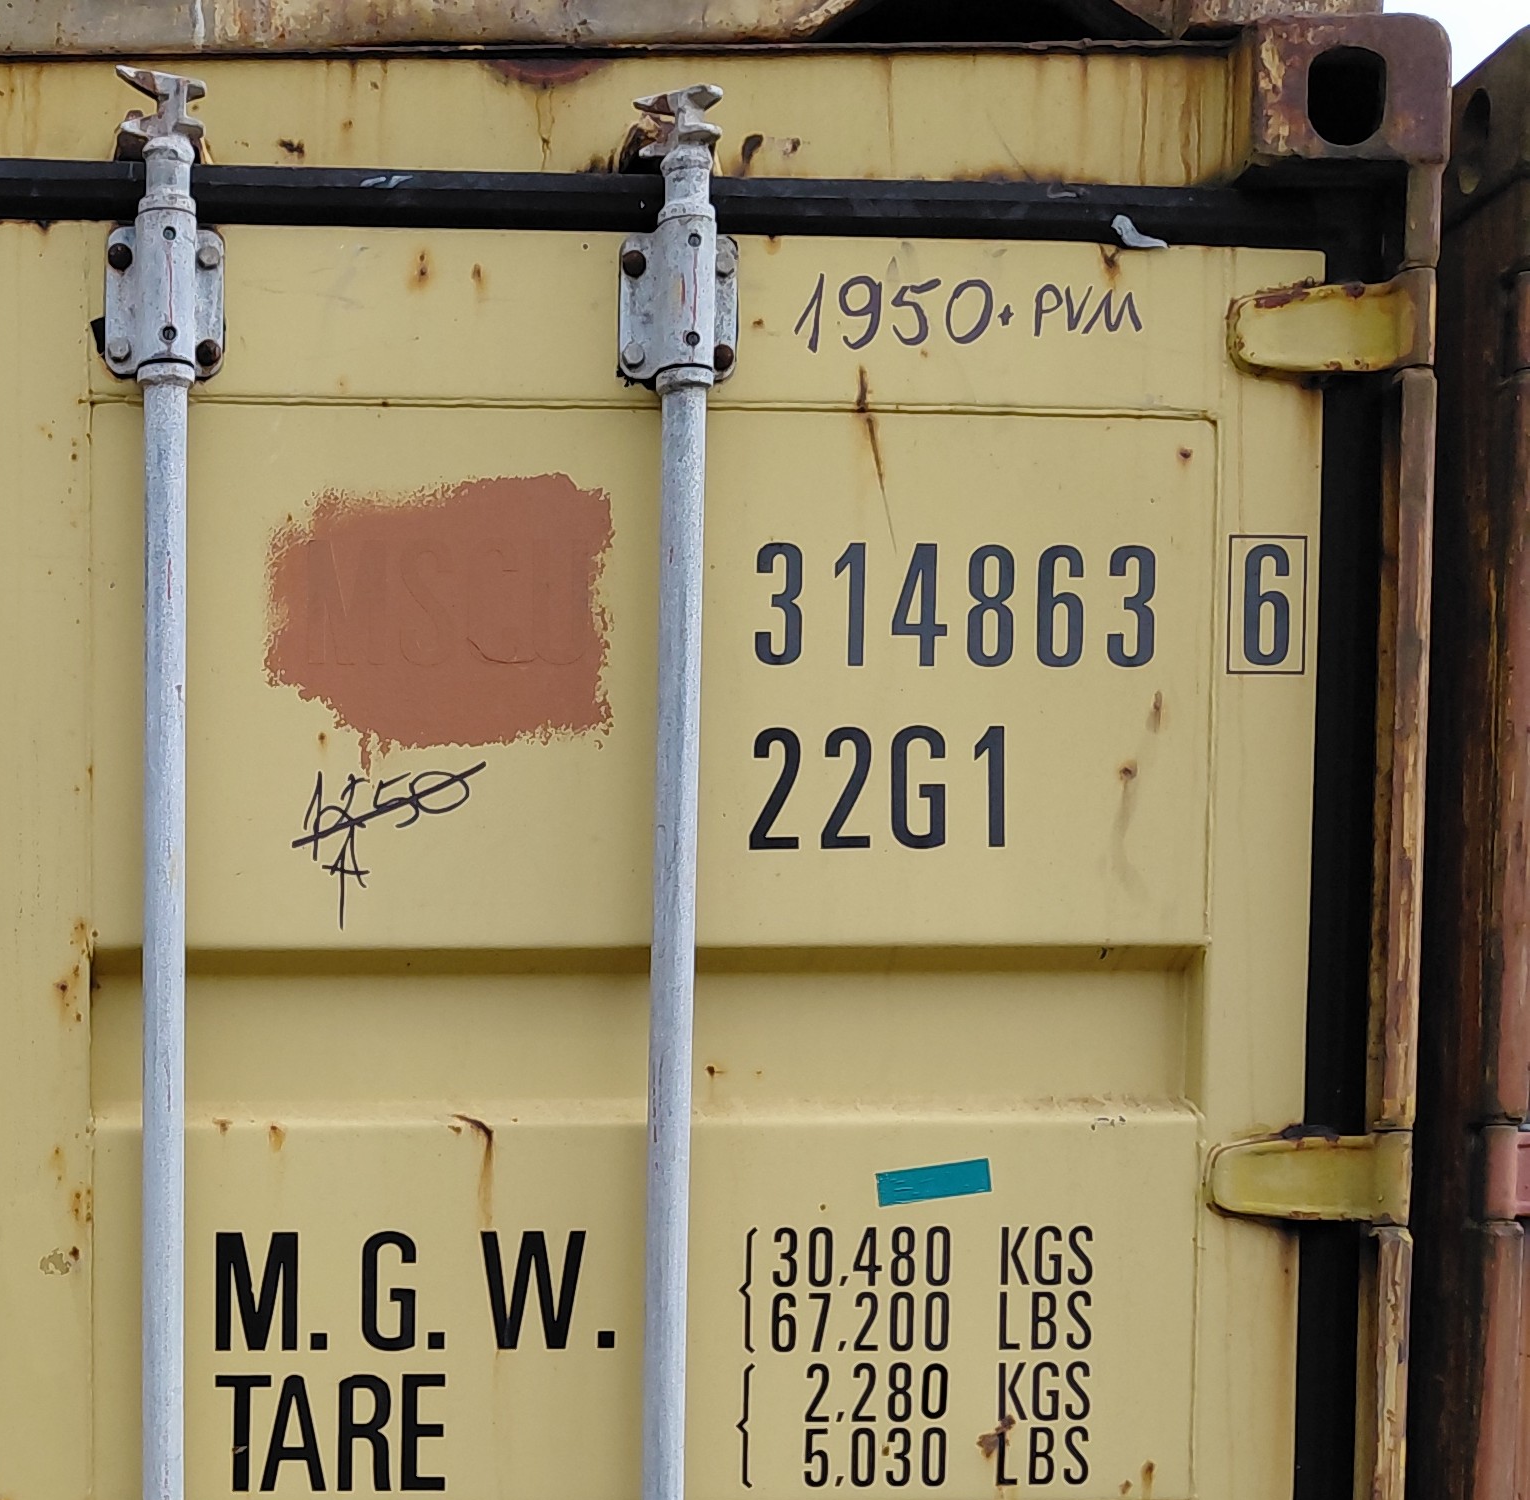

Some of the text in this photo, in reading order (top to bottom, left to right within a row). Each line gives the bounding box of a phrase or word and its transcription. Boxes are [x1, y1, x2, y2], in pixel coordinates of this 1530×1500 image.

[1033, 283, 1144, 338] PVM
[754, 541, 1291, 668] 314863 6
[748, 724, 1006, 850] 22G1
[772, 1224, 1094, 1288] 30,480 KGS
[770, 1290, 1092, 1354] 67,200 LBS
[804, 1360, 1091, 1424] 2,280 KGS
[214, 1373, 446, 1492] TARE
[803, 1425, 1090, 1488] 5,030 LBS
